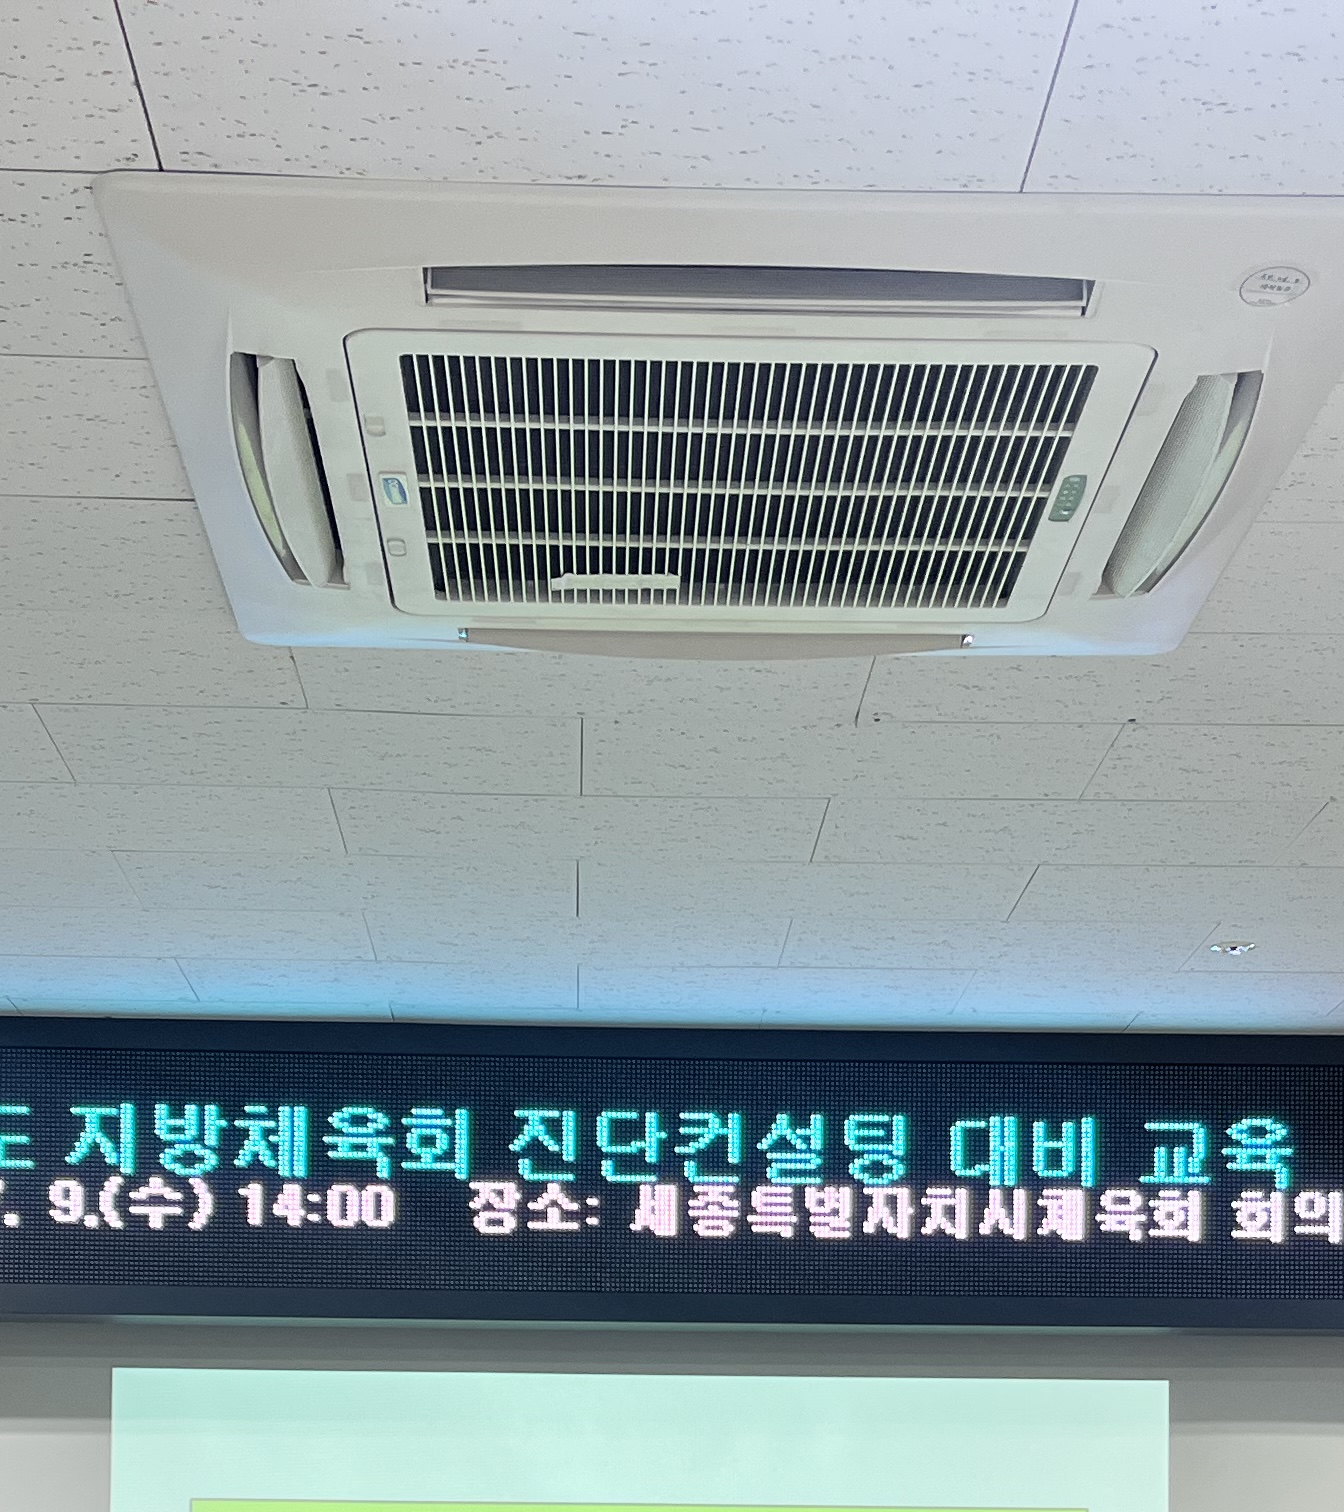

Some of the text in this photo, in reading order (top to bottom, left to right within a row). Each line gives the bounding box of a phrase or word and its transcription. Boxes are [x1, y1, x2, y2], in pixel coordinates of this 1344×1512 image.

[66, 1102, 471, 1181] 지방체육회
[509, 1108, 908, 1187] 진단컨설팅
[949, 1114, 1097, 1190] 대비
[1140, 1116, 1295, 1191] 교육
[236, 1182, 396, 1229] 14:00
[467, 1180, 600, 1235] 장소:
[629, 1184, 1203, 1243] 세종특별자치시체육회
